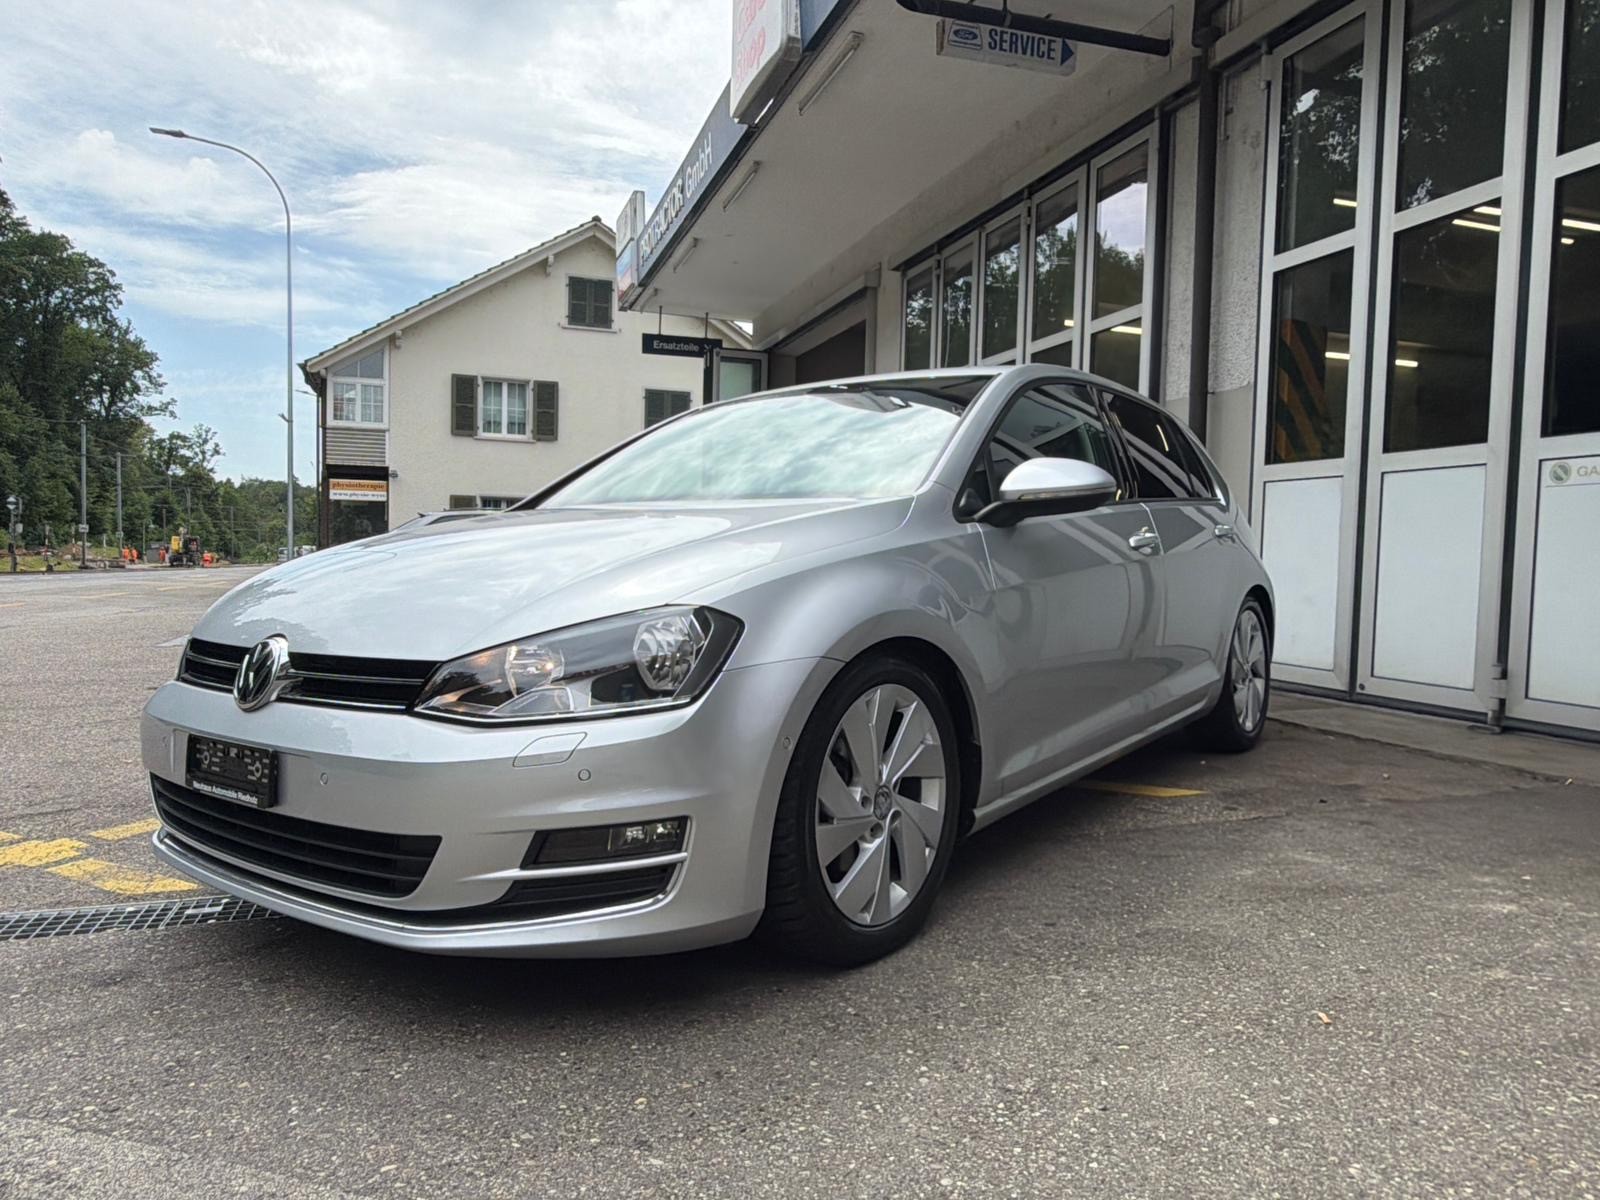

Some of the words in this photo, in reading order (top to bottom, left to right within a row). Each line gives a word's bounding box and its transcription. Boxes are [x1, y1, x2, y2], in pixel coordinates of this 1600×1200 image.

[988, 28, 1057, 60] SERVICE
[685, 132, 713, 198] GmbH
[653, 340, 700, 352] Ersatzteile
[332, 481, 385, 489] physiotherapie
